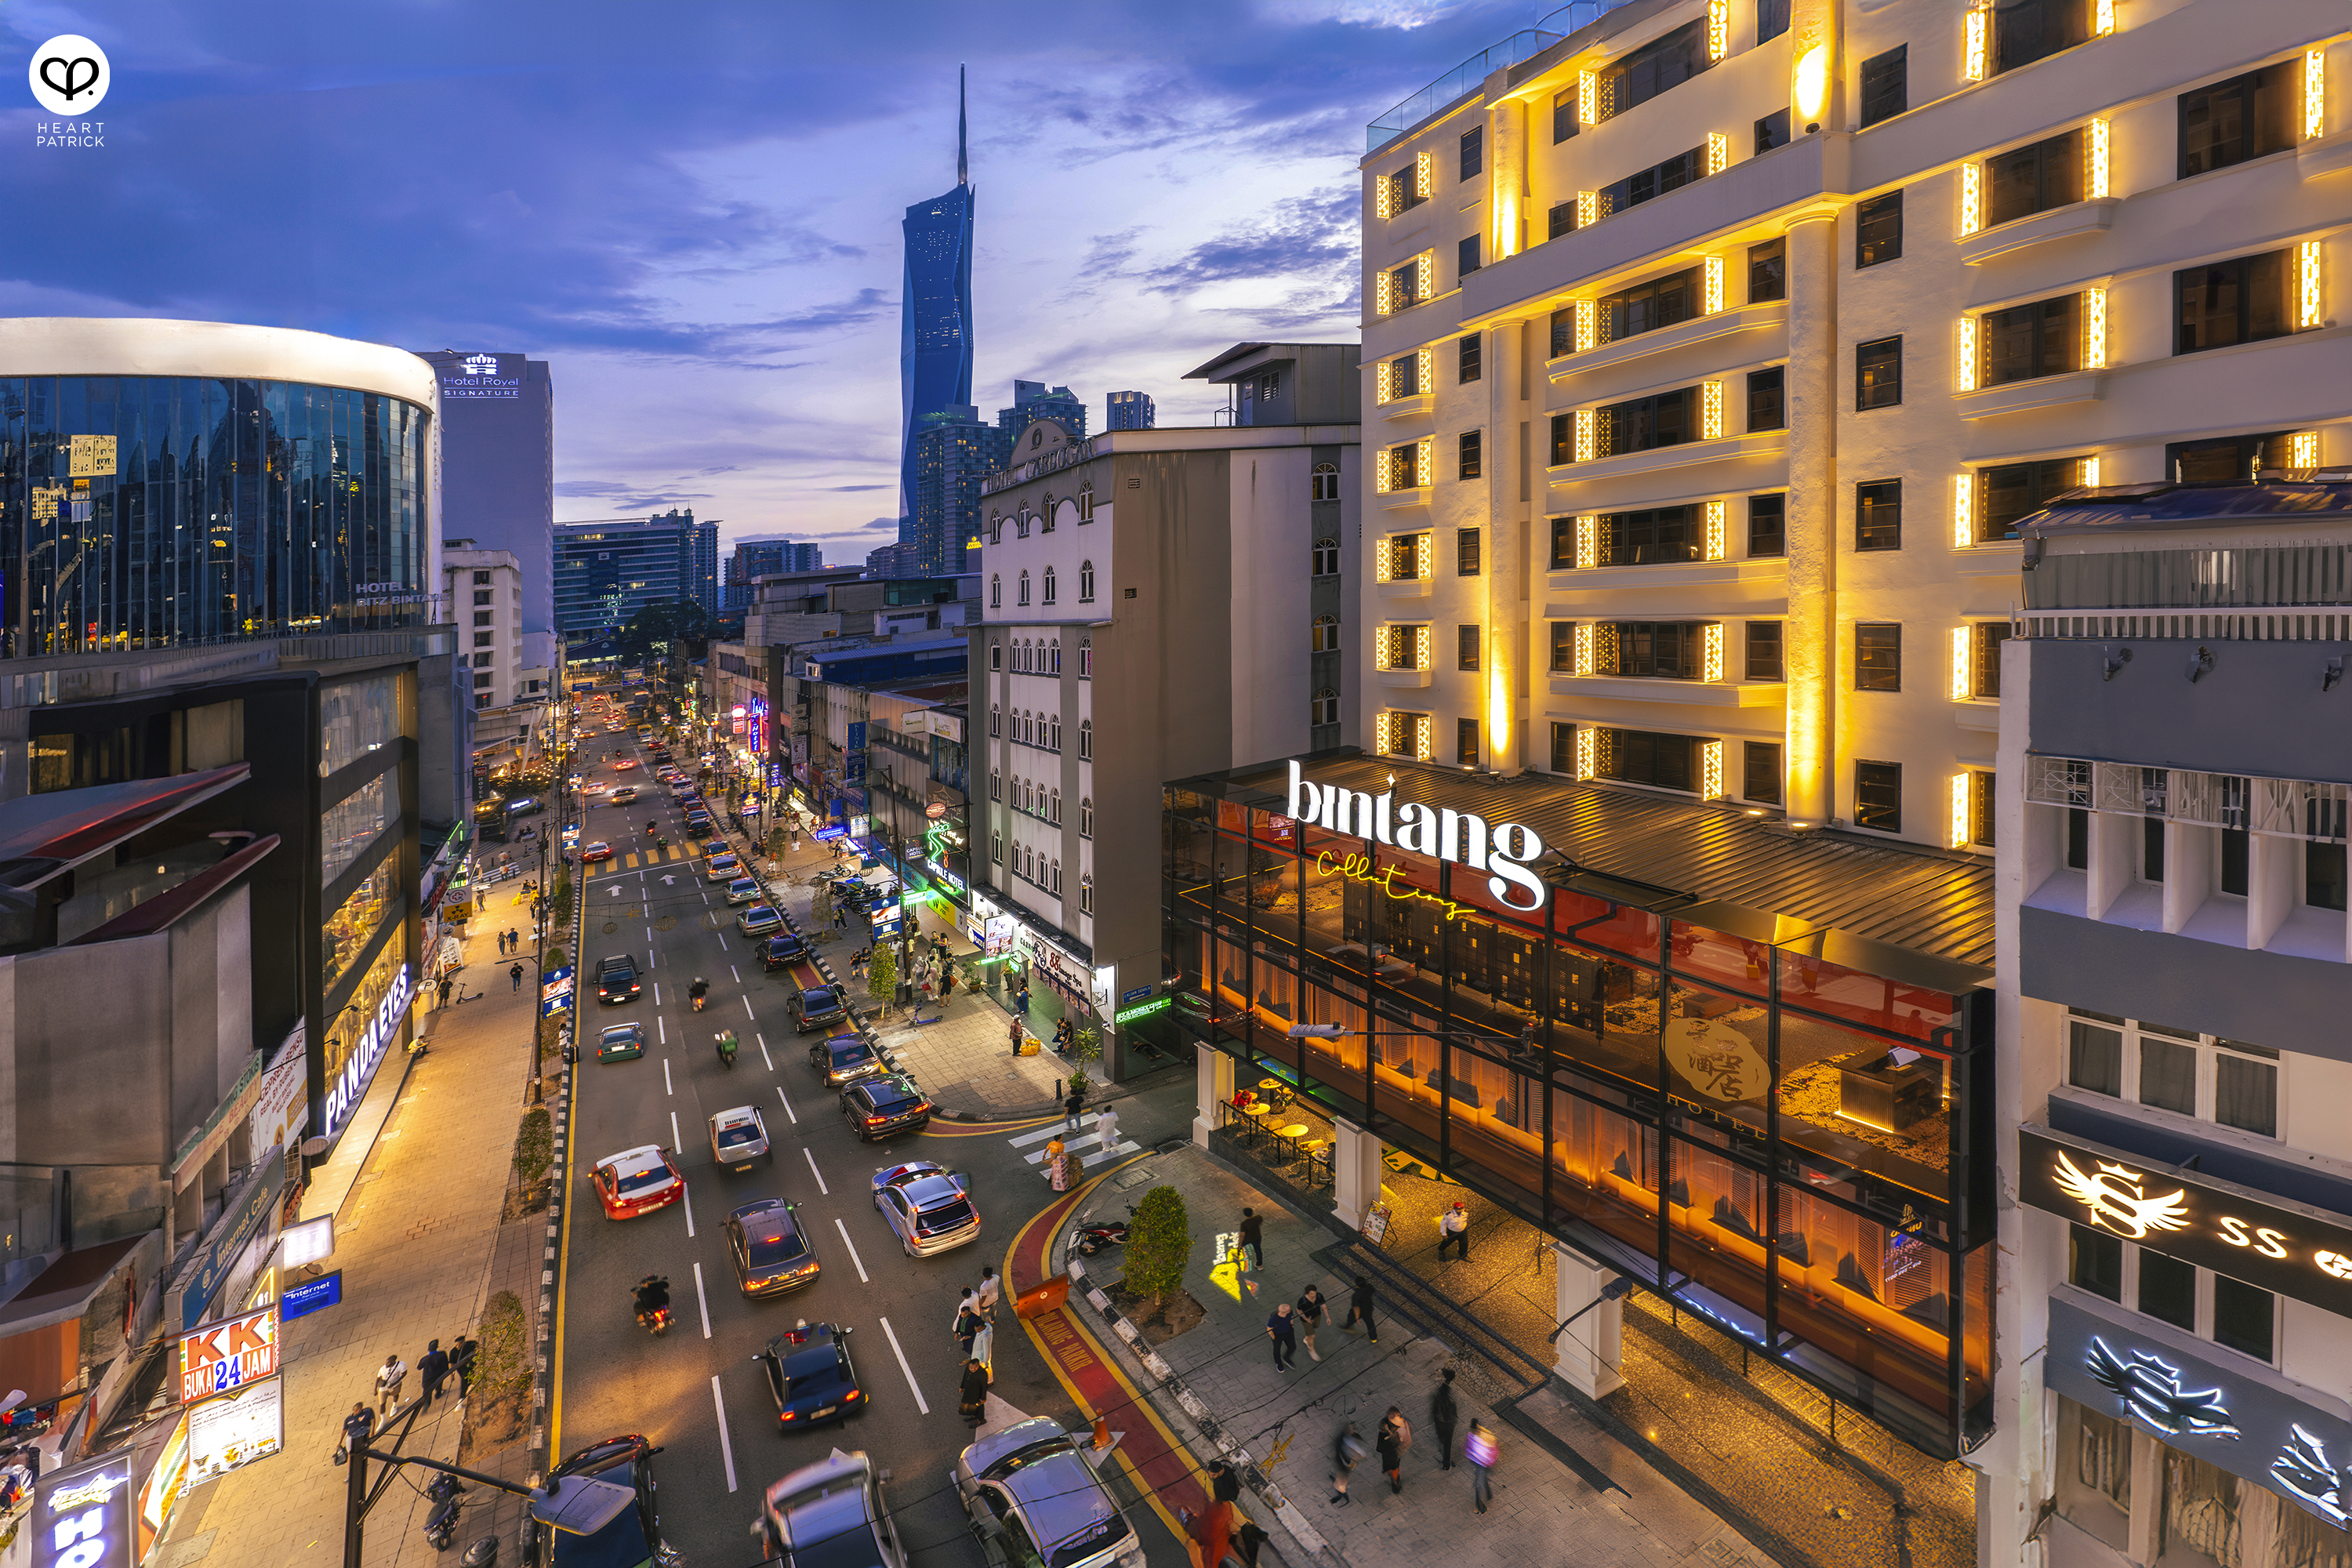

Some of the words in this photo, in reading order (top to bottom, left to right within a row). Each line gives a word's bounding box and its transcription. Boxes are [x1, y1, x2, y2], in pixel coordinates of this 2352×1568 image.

[443, 376, 478, 386] Hotel
[483, 377, 519, 387] Royal
[987, 467, 1019, 493] HOTEL
[356, 582, 407, 593] HOTEL
[356, 597, 389, 607] BITZ
[392, 593, 449, 604] BINTANG
[1287, 759, 1545, 912] bintang
[447, 912, 469, 921] X-RAY
[1050, 952, 1059, 971] 88
[325, 1018, 379, 1138] PANDA
[379, 963, 408, 1041] EYES
[239, 1056, 260, 1093] STOKIS
[228, 1075, 260, 1124] BEAUTY
[260, 1097, 272, 1118] REAL
[272, 1086, 278, 1098] BY
[1666, 1092, 1766, 1141] HOTEL
[216, 1211, 250, 1269] Internet
[251, 1185, 268, 1217] Café
[290, 1281, 330, 1299] Internet
[1034, 1312, 1073, 1345] DILARANG
[1057, 1342, 1094, 1373] PARKIR
[184, 1367, 212, 1400] BUKA
[215, 1356, 241, 1392] 24
[243, 1346, 270, 1379] JAM
